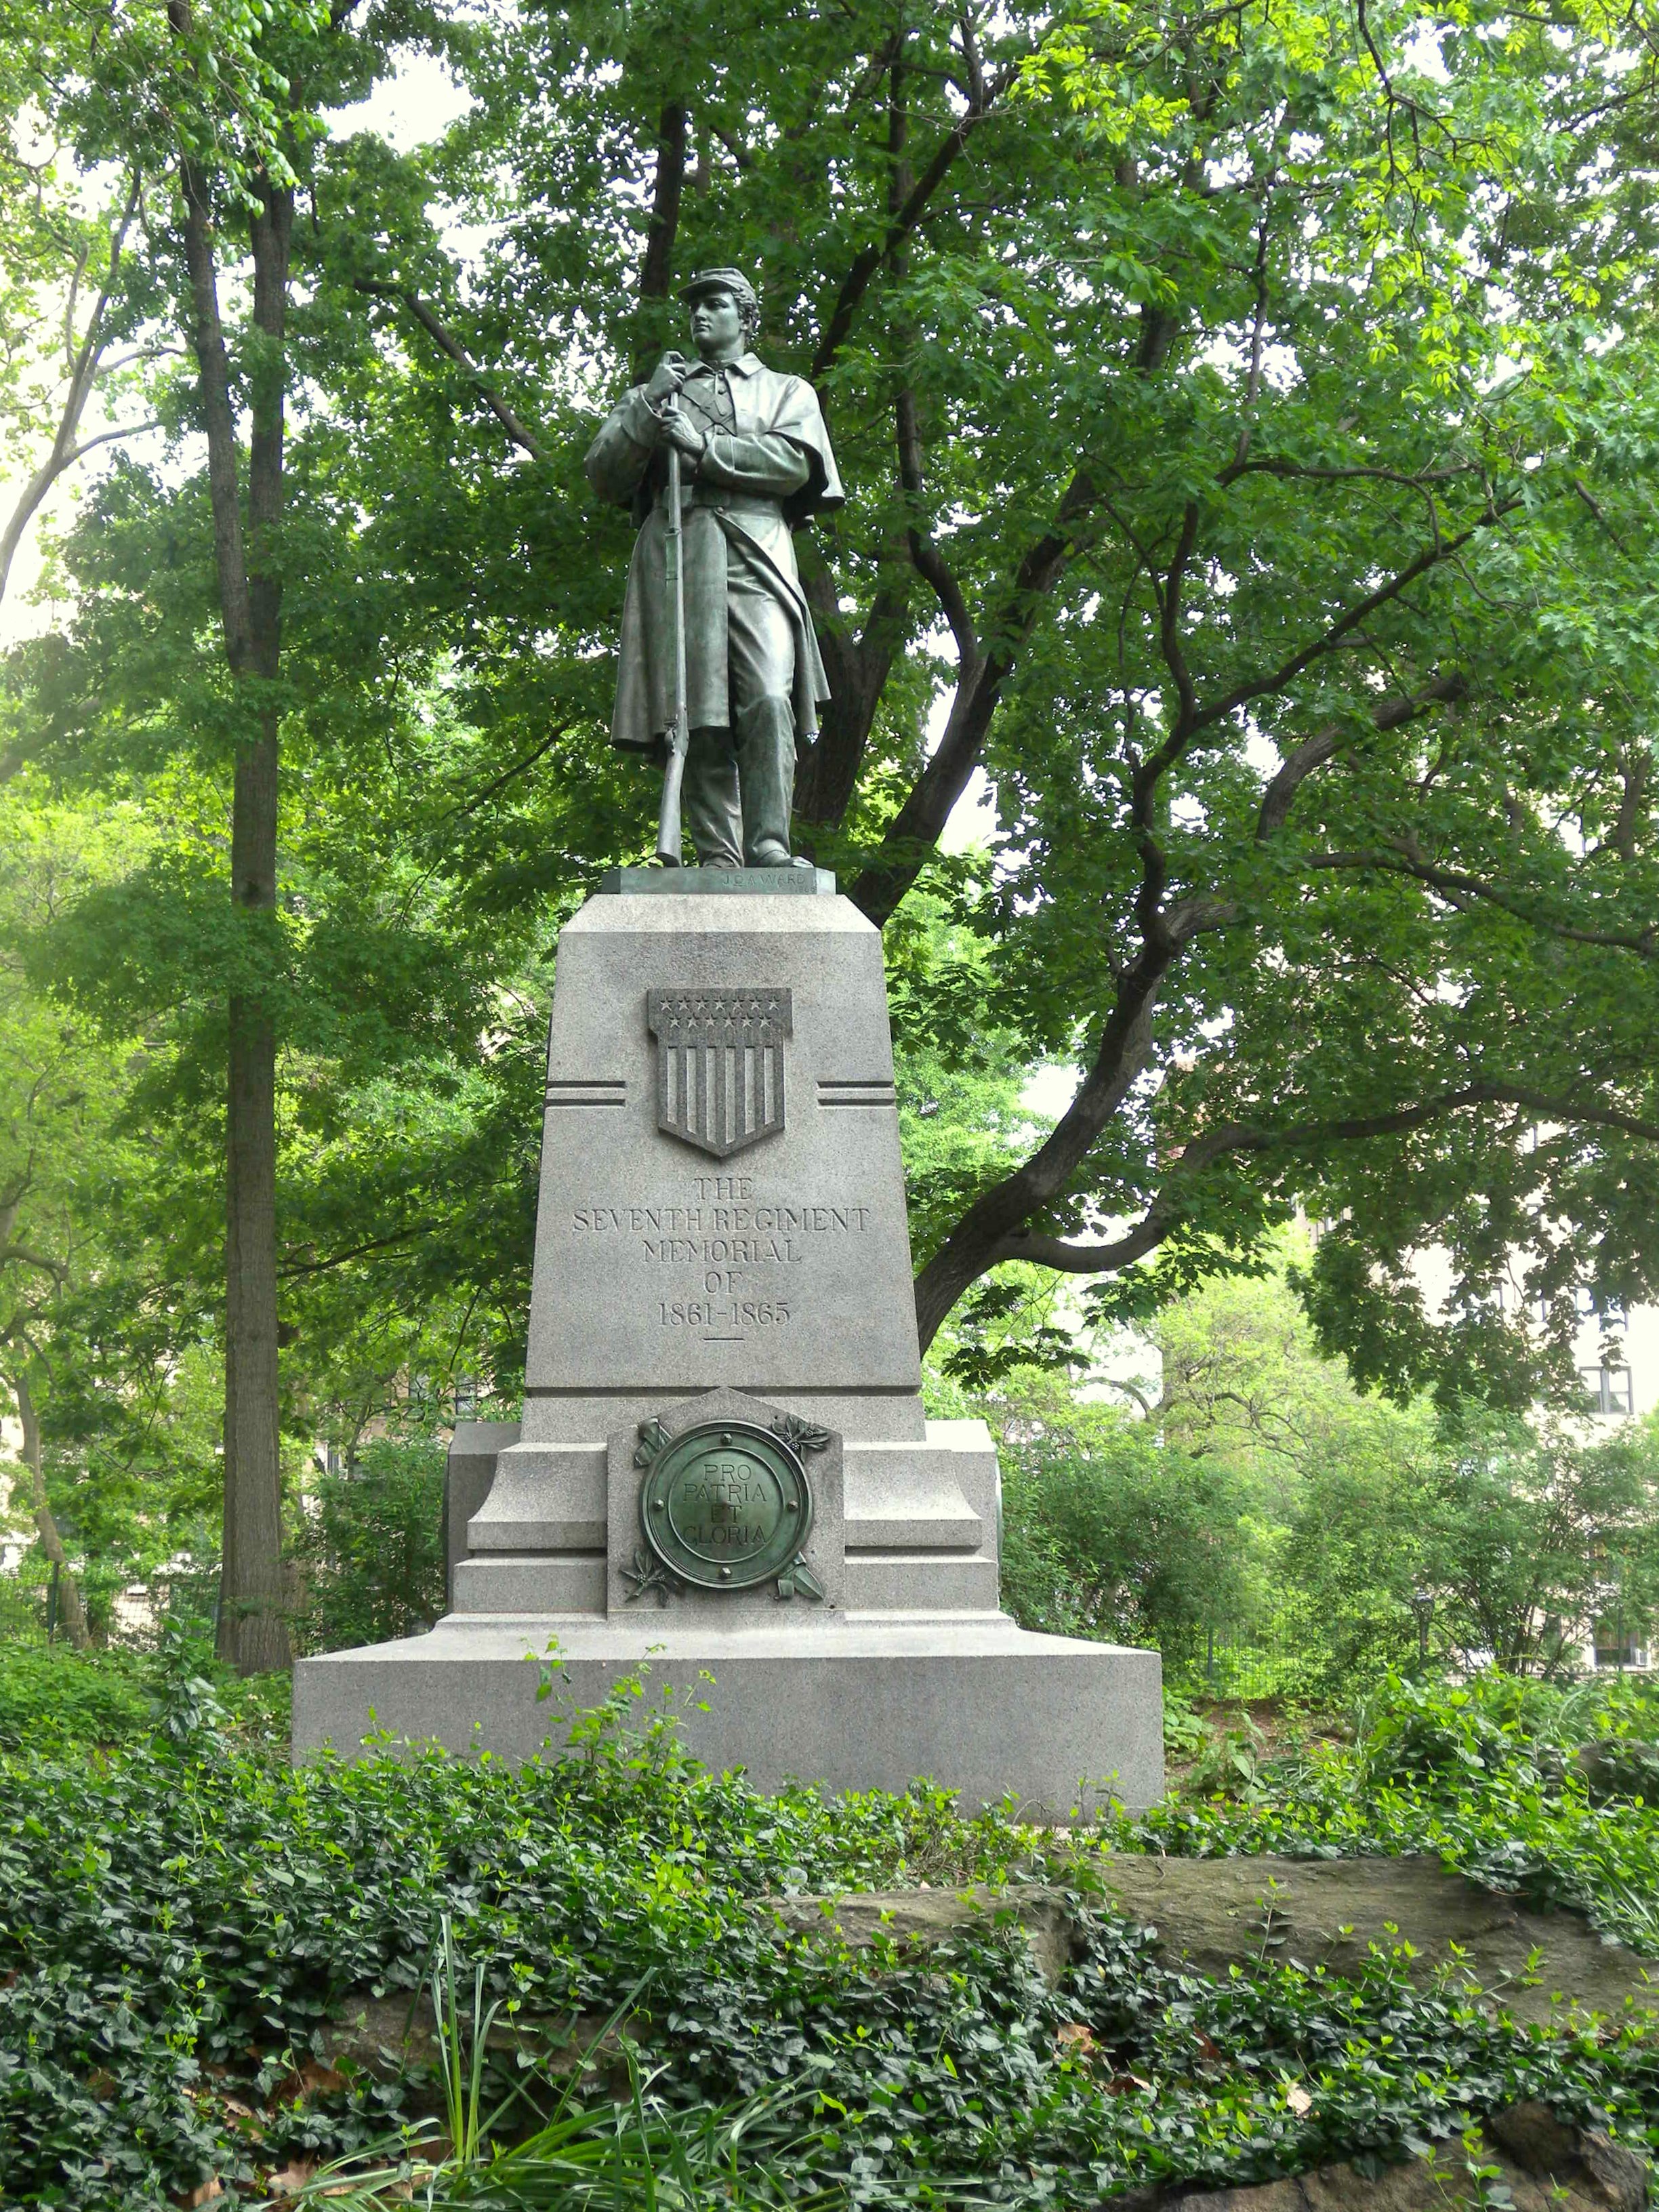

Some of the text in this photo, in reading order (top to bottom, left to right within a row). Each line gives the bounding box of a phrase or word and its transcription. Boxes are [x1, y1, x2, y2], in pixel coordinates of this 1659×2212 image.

[760, 874, 806, 886] WARD
[695, 1177, 753, 1201] THE
[572, 1208, 872, 1232] SEVENTH REGIMENT
[642, 1240, 802, 1263] MEMORIAL
[704, 1271, 744, 1294] OF
[659, 1303, 790, 1326] 1861-1865
[703, 1464, 752, 1482] PRO
[682, 1483, 767, 1502] PATRIA
[710, 1505, 742, 1523] ET
[683, 1525, 767, 1545] GLORIA
